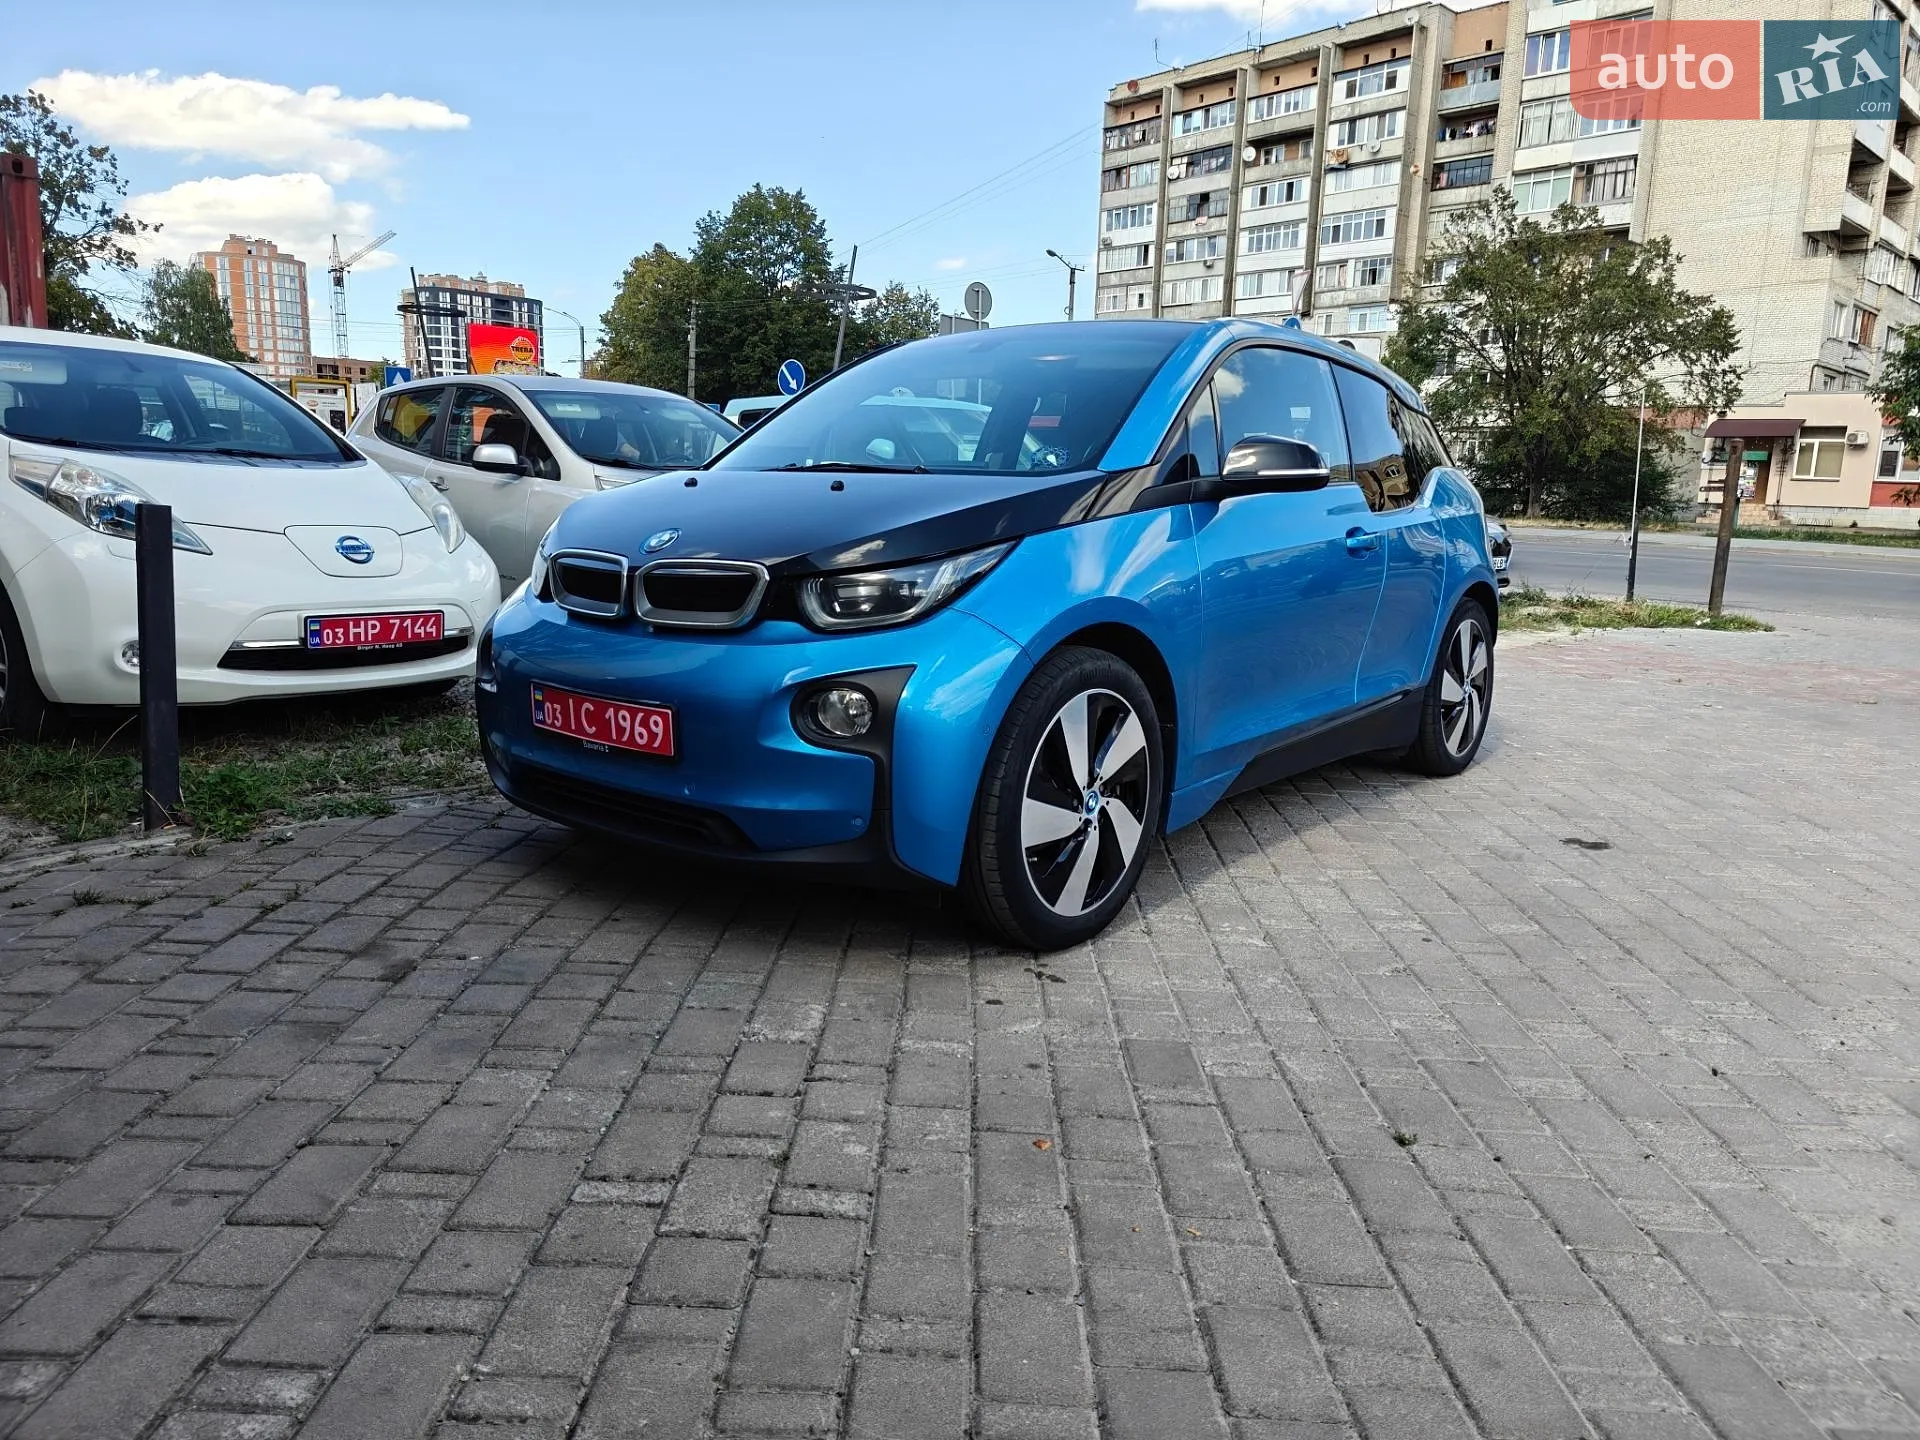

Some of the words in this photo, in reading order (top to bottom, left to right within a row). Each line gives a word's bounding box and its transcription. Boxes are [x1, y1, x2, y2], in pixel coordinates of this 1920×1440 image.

[323, 628, 344, 644] 03
[349, 620, 380, 642] HP
[389, 617, 437, 640] 7144
[535, 711, 544, 720] UA
[544, 702, 562, 727] 03
[568, 698, 596, 734] IC
[605, 707, 664, 748] 1969
